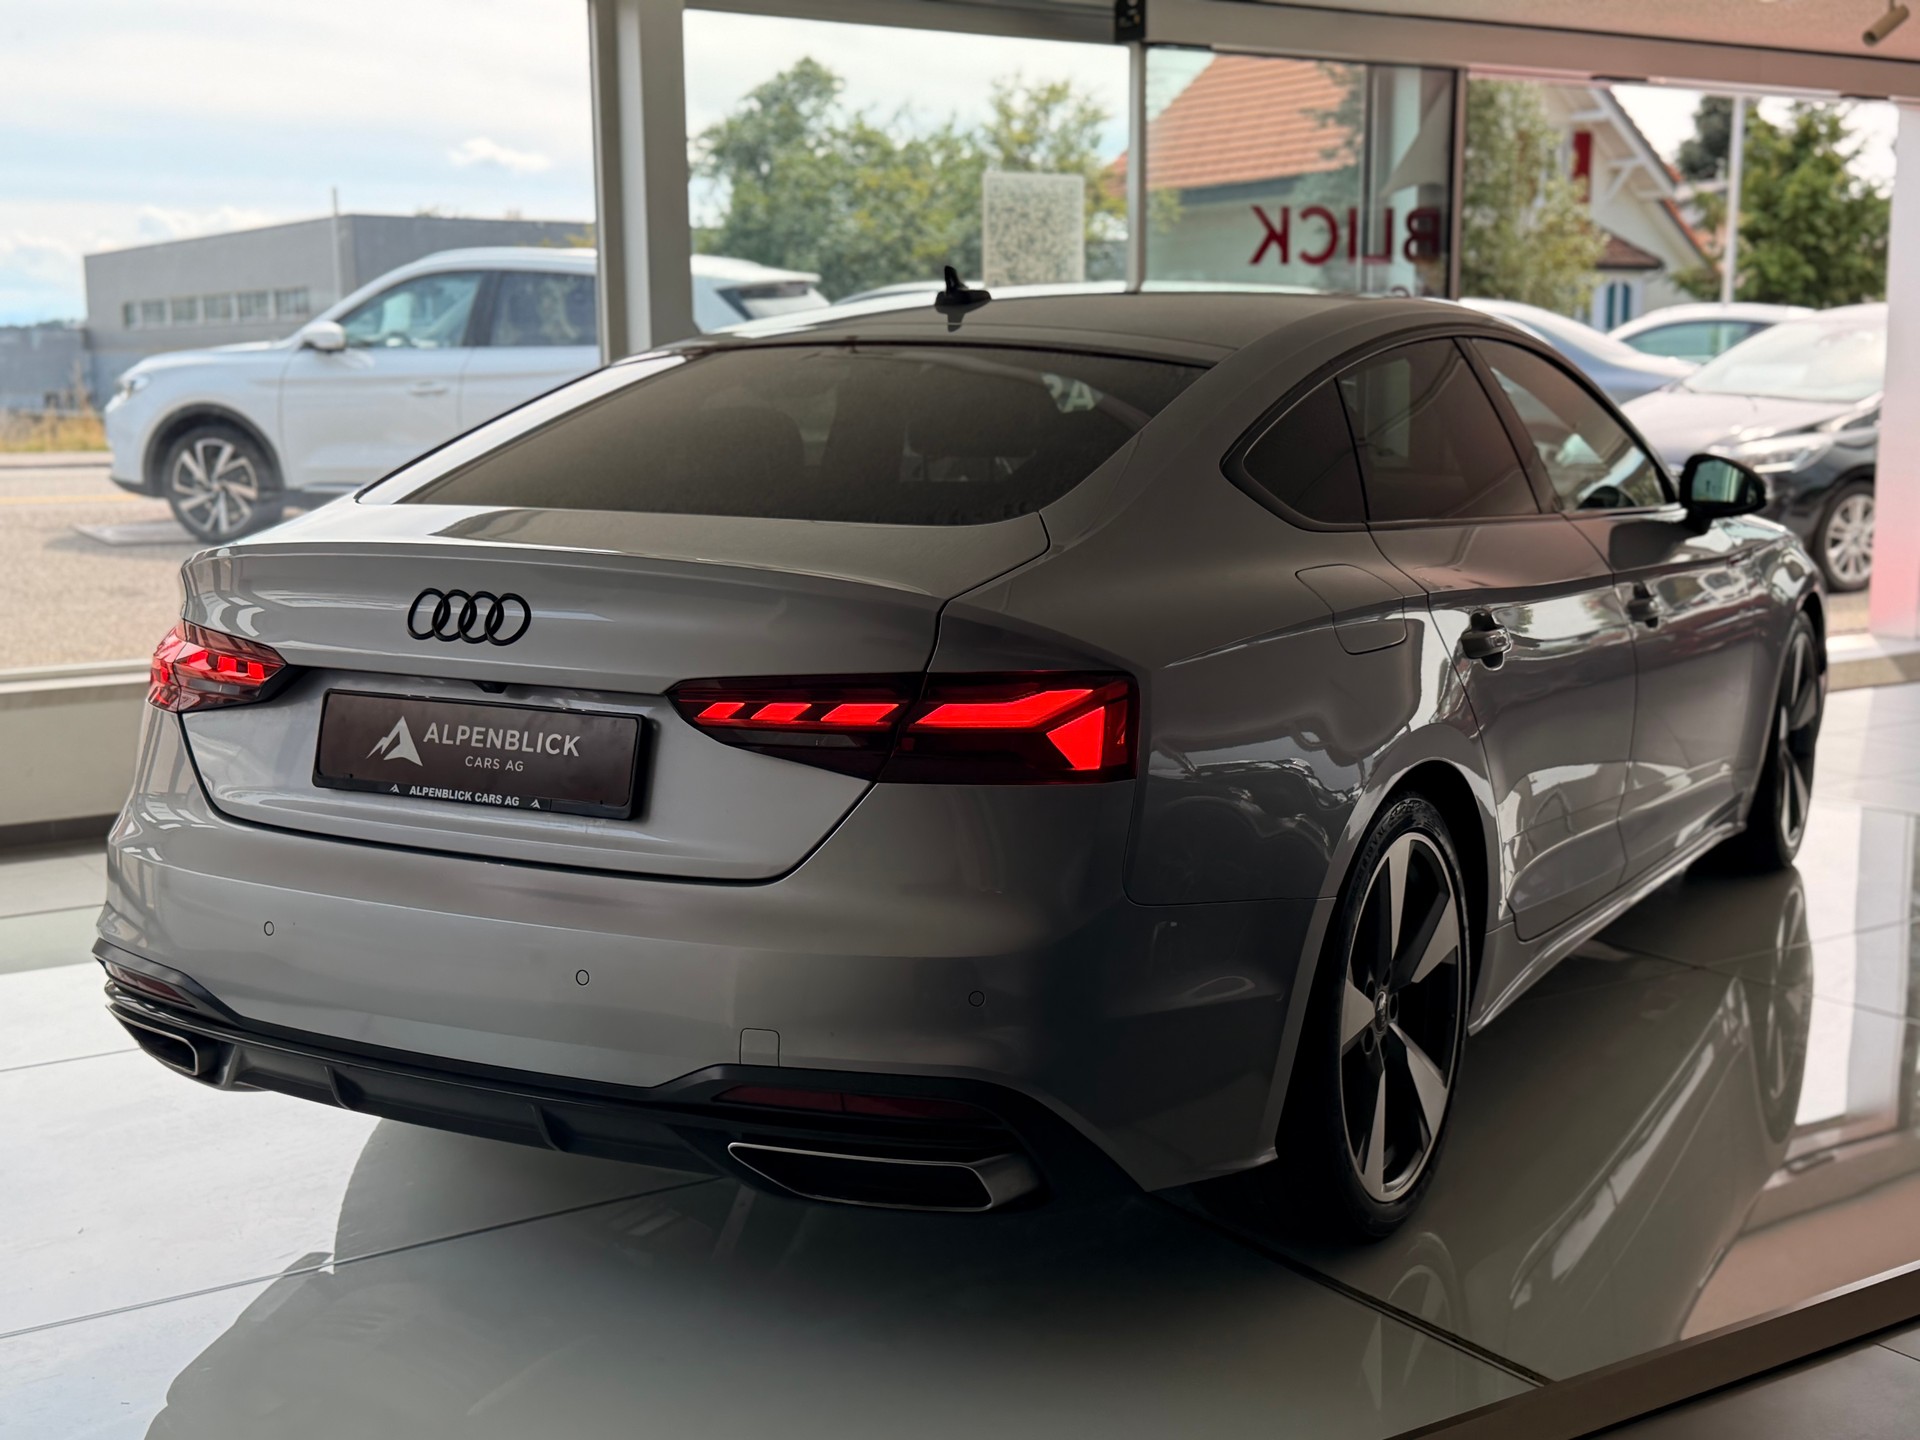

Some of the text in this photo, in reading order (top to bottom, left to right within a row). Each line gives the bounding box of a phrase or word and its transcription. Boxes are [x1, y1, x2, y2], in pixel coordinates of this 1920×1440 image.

[422, 721, 581, 757] ALPENBLICK
[464, 755, 524, 772] CARS AG
[409, 785, 520, 806] ALPENBLICK CARS AG
